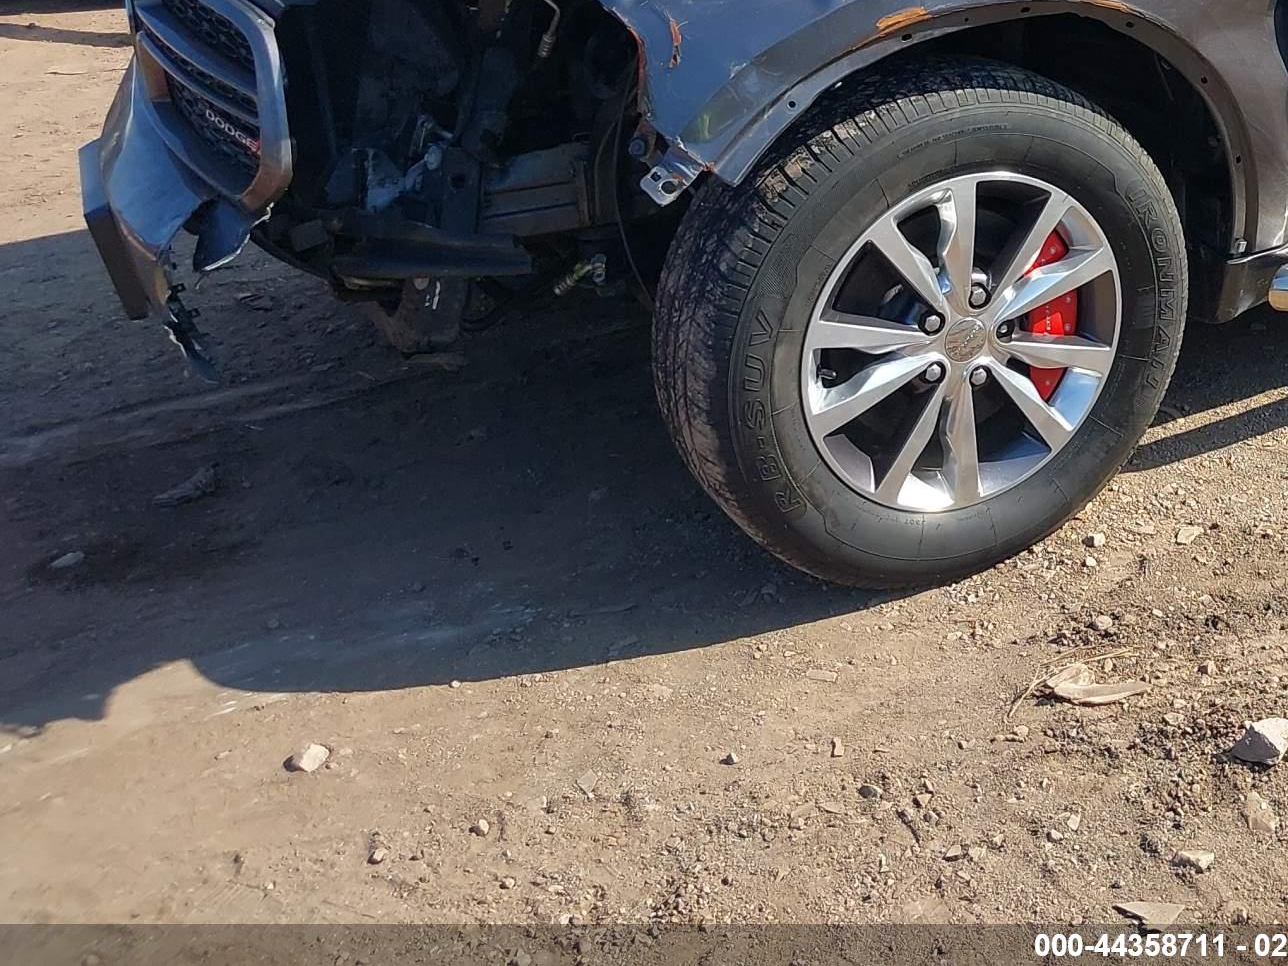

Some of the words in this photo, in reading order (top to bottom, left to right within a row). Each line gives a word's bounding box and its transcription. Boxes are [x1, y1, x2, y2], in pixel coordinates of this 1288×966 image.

[206, 109, 257, 152] DODGE
[1127, 189, 1176, 390] IRONMAN
[744, 306, 802, 513] RB-SUV
